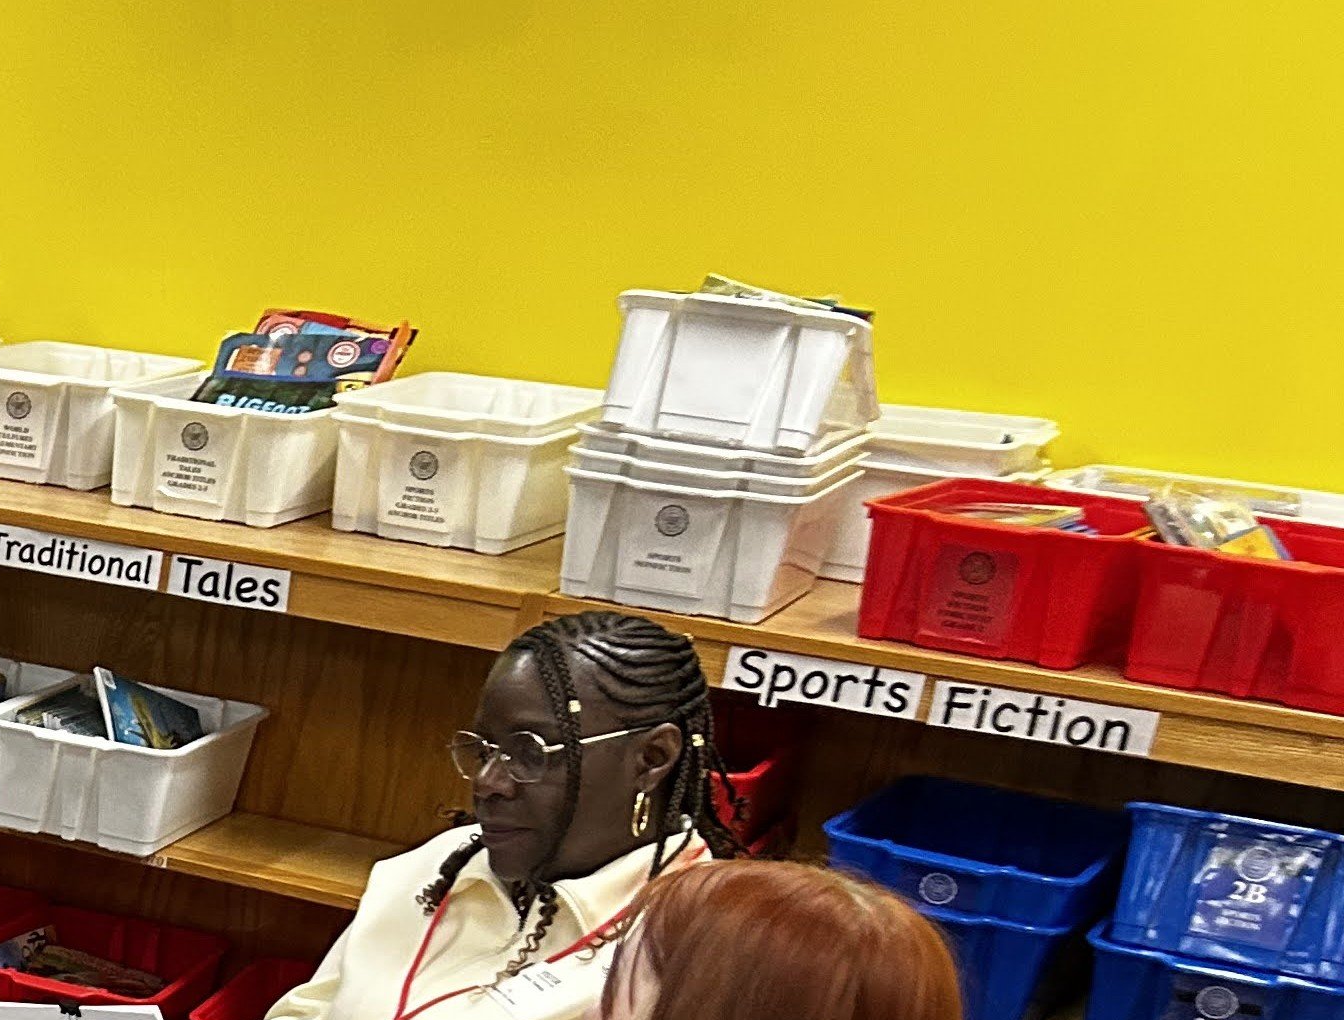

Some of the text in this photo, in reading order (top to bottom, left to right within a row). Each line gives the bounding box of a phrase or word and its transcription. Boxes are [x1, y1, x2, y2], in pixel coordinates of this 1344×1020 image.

[177, 557, 281, 608] Tales
[734, 650, 1131, 752] Sports Fiction
[1228, 880, 1268, 904] 2B
